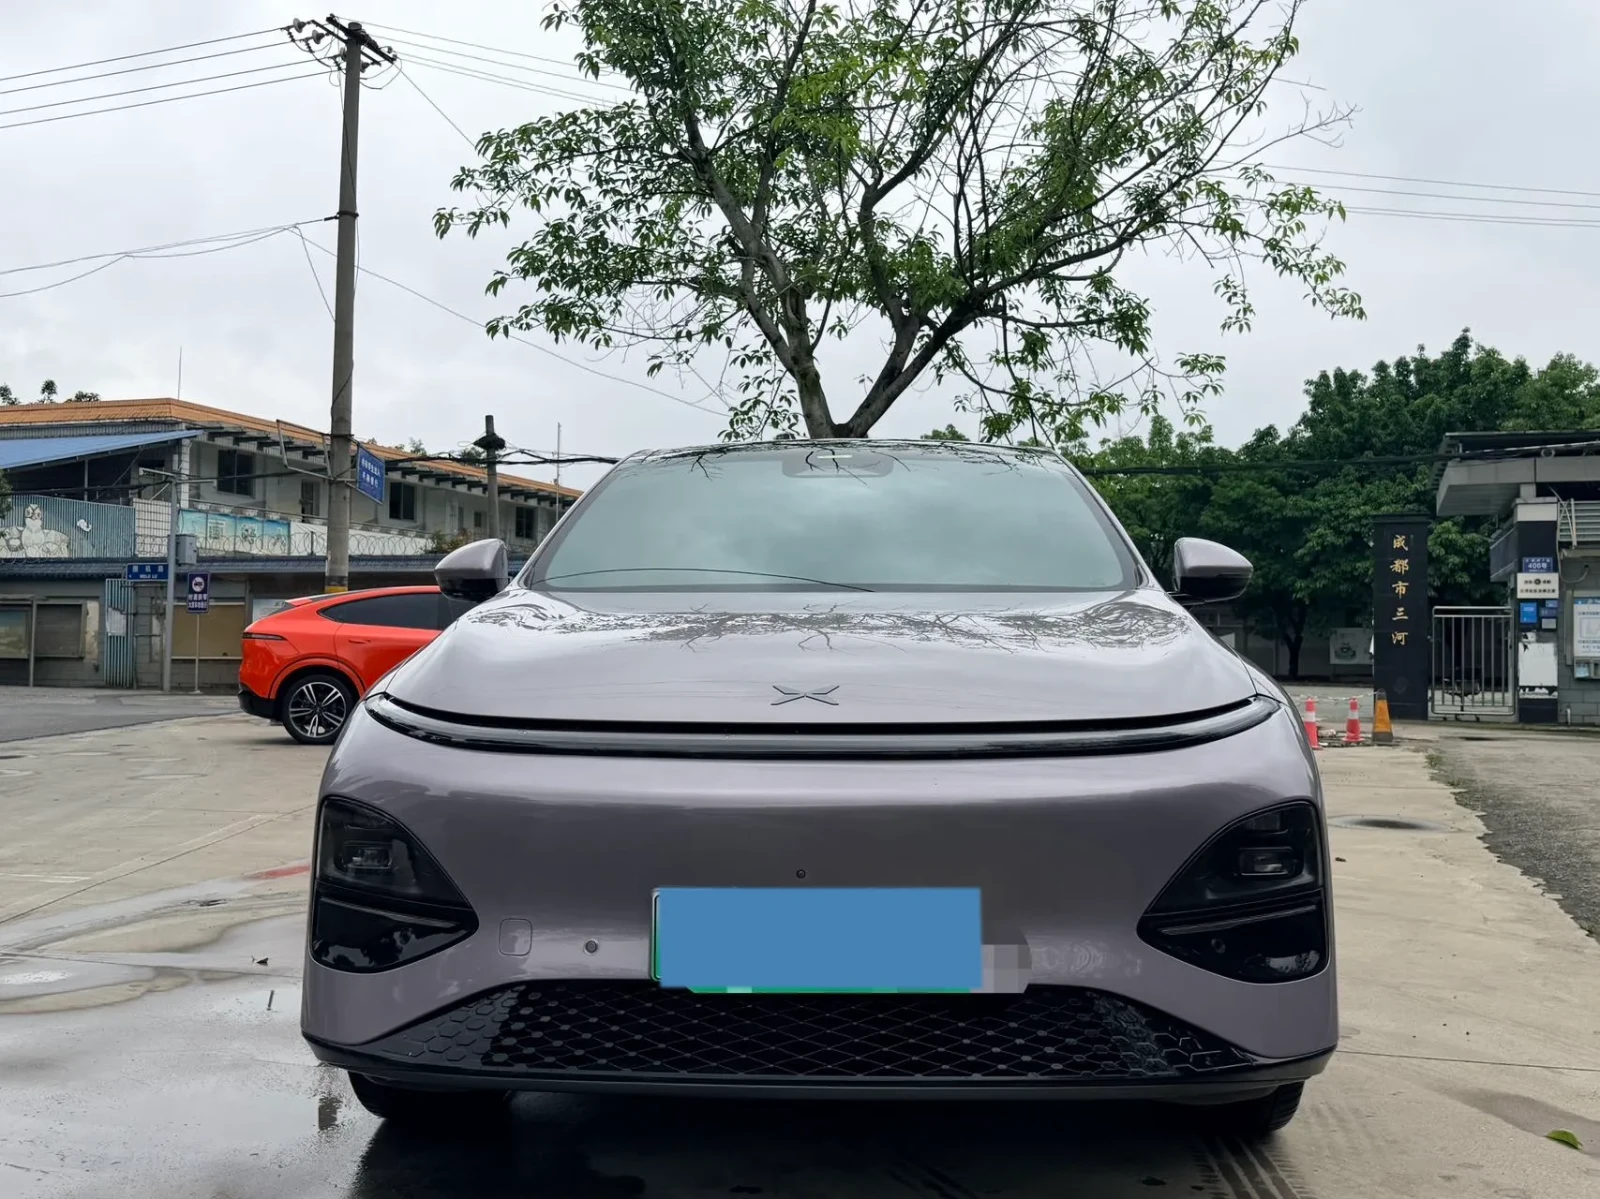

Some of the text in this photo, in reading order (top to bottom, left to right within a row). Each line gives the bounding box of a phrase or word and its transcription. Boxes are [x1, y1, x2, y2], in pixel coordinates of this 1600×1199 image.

[1390, 534, 1409, 645] 成都市三河
